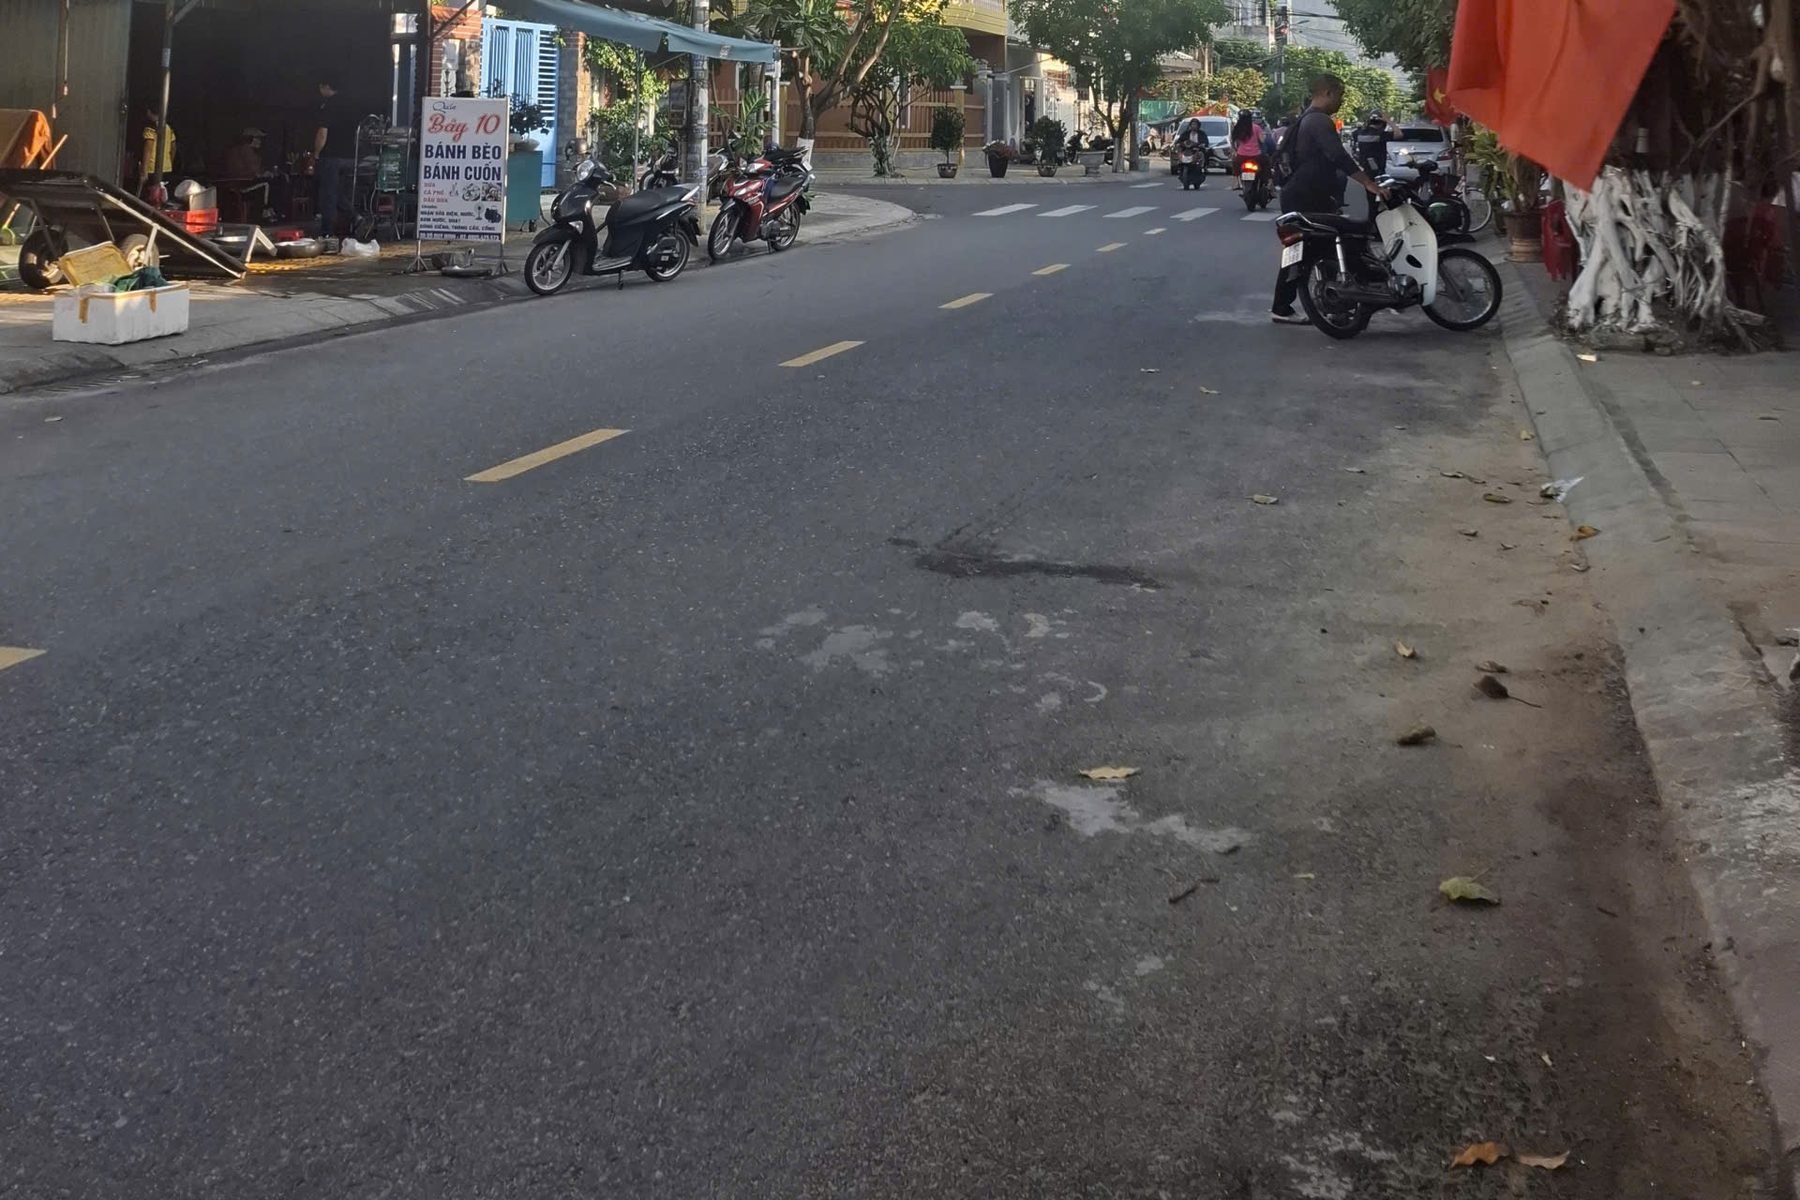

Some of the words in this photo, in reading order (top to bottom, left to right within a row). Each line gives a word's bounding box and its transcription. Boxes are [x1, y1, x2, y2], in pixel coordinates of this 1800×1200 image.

[475, 112, 501, 135] 10
[425, 141, 466, 159] BÁNH
[472, 142, 502, 160] BÈO
[423, 162, 460, 180] BÁNH
[464, 161, 501, 181] CUỐN
